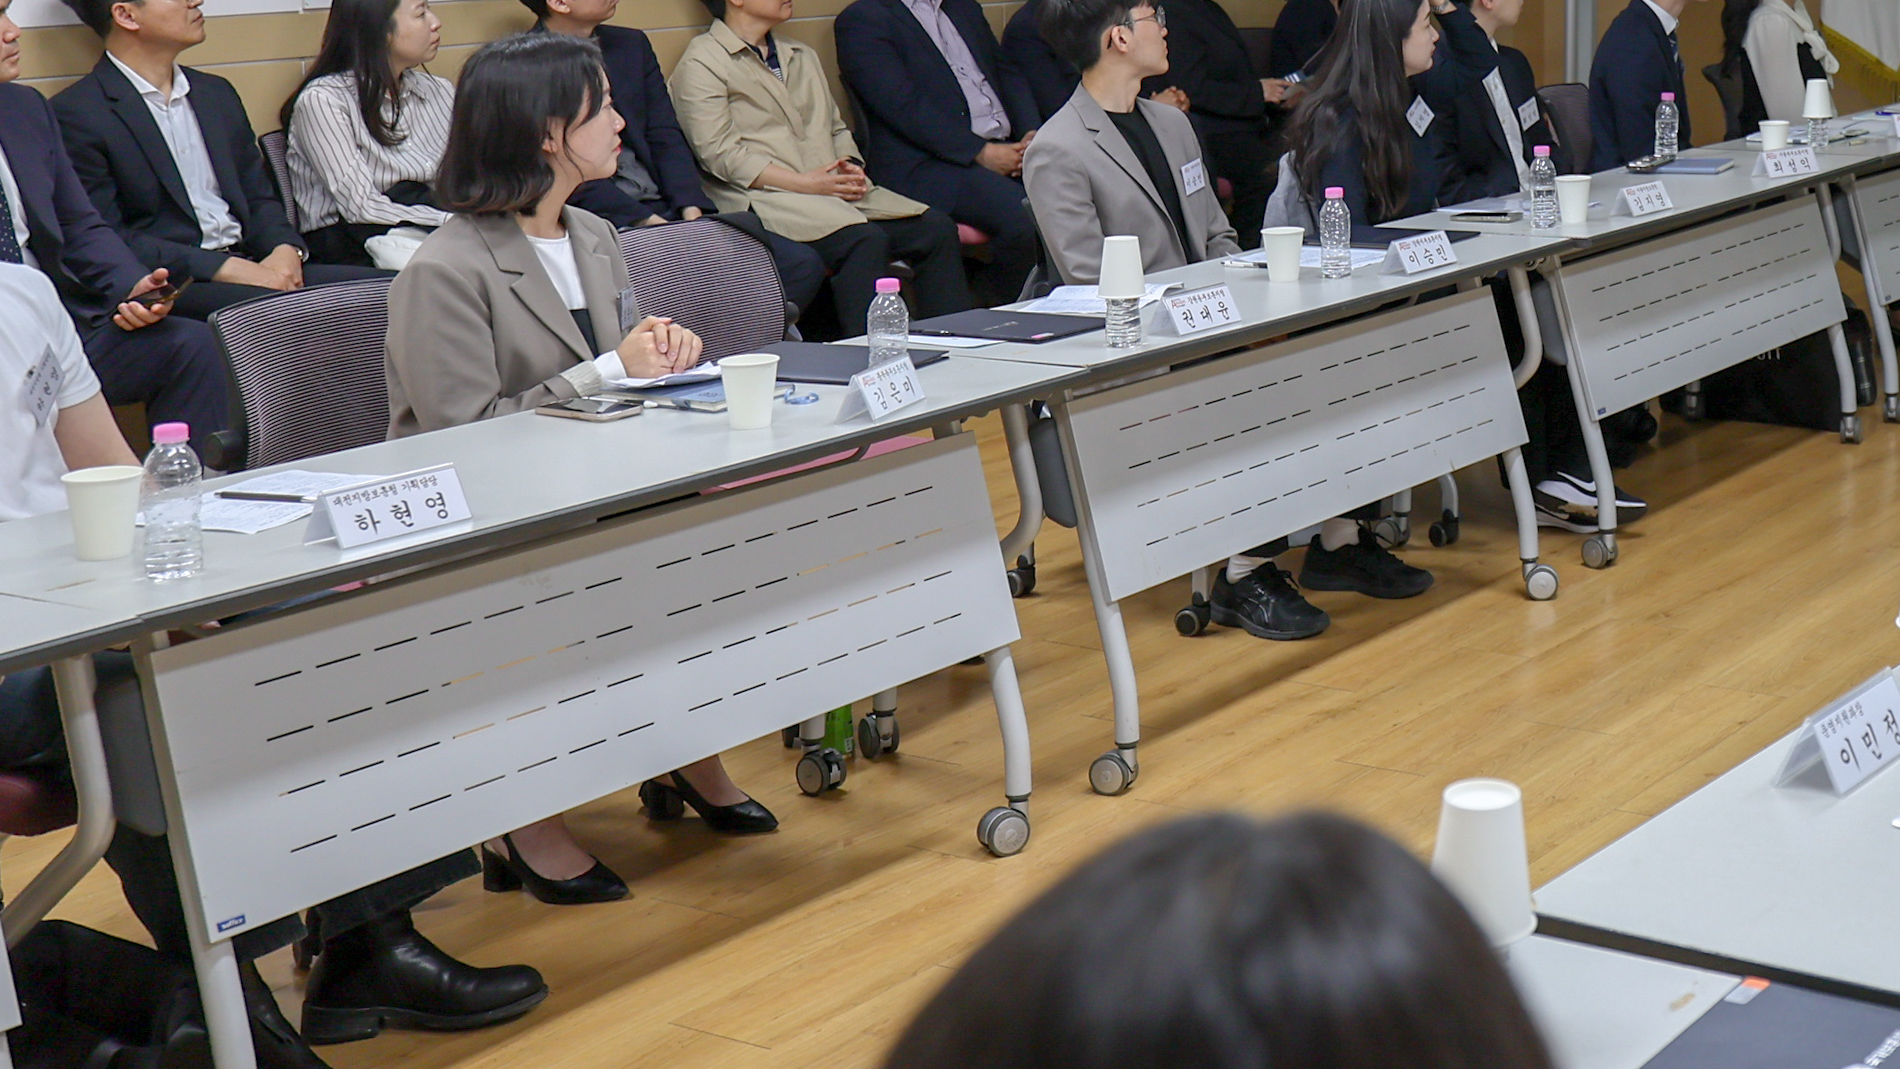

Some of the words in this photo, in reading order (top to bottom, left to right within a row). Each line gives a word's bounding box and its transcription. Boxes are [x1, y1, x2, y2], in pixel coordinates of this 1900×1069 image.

[1408, 243, 1448, 268] 이승민
[1181, 300, 1230, 329] 권대윤
[873, 375, 916, 410] 김은미
[333, 483, 399, 508] 대전지방보훈청
[401, 474, 438, 492] 기획담당
[353, 491, 449, 535] 하현영
